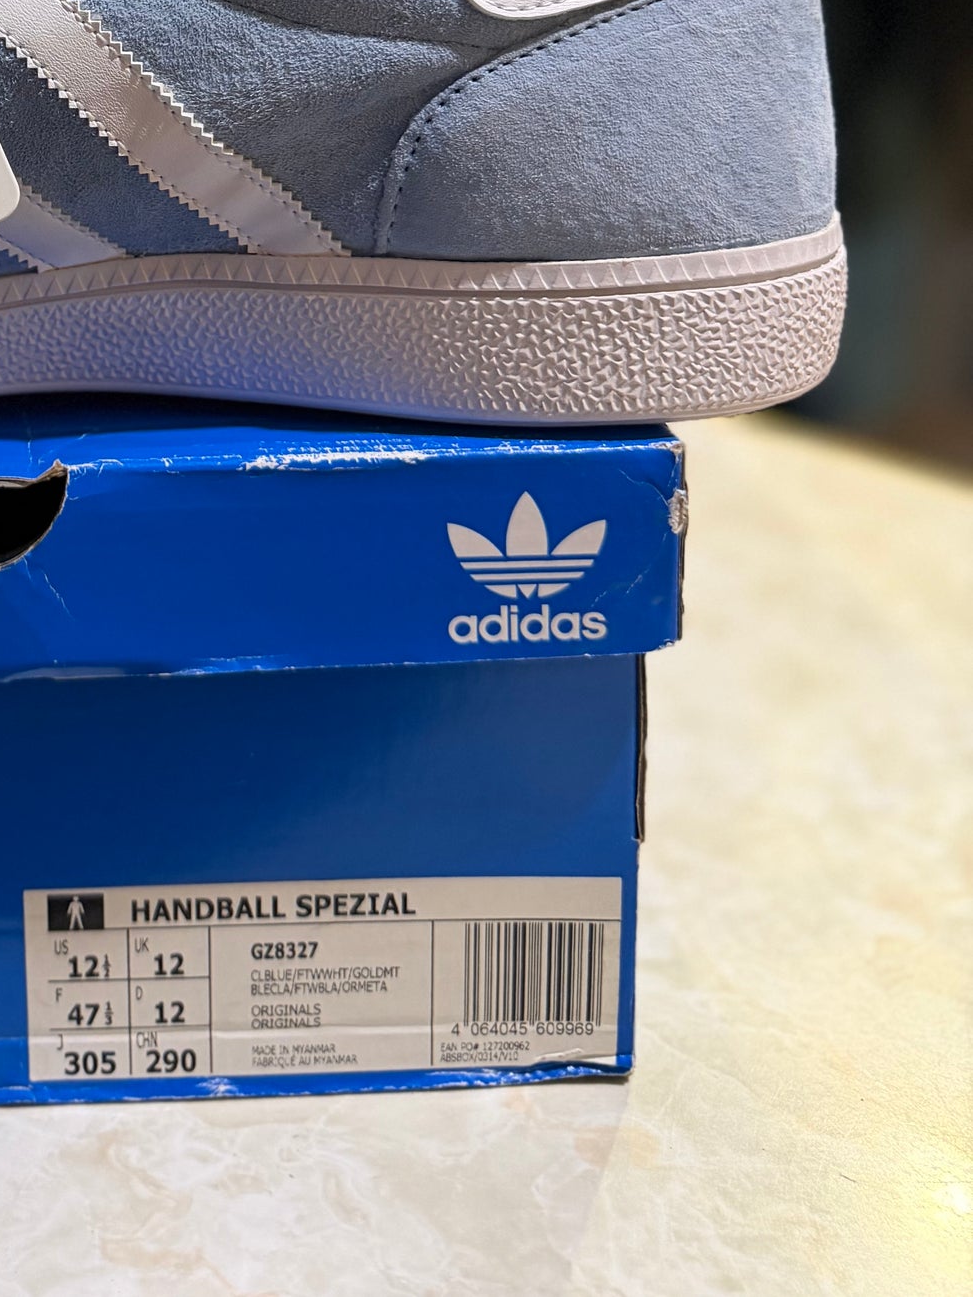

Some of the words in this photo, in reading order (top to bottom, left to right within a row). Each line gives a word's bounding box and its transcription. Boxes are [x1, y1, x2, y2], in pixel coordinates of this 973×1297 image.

[448, 604, 607, 644] adidas
[131, 895, 286, 922] HANDBALL
[295, 892, 416, 918] SPEZIAL
[54, 939, 69, 954] US
[135, 937, 149, 952] UK
[251, 941, 318, 960] GZ8327
[154, 952, 185, 976] 12
[251, 966, 400, 984] CLBLUE/FTWWHT/GOLDMT
[55, 987, 63, 1002] F
[135, 986, 143, 1000] D
[251, 981, 387, 997] BLECLA/FTWBLA/ORMETA
[155, 1001, 185, 1024] 12
[251, 1004, 321, 1017] ORIGINALS
[251, 1017, 321, 1030] ORIGINALS
[451, 1022, 460, 1036] 4
[471, 1022, 528, 1036] 064045
[535, 1022, 594, 1036] 609969
[57, 1034, 64, 1051] J
[136, 1031, 158, 1049] CHN
[64, 1051, 117, 1076] 305
[145, 1048, 197, 1074] 290
